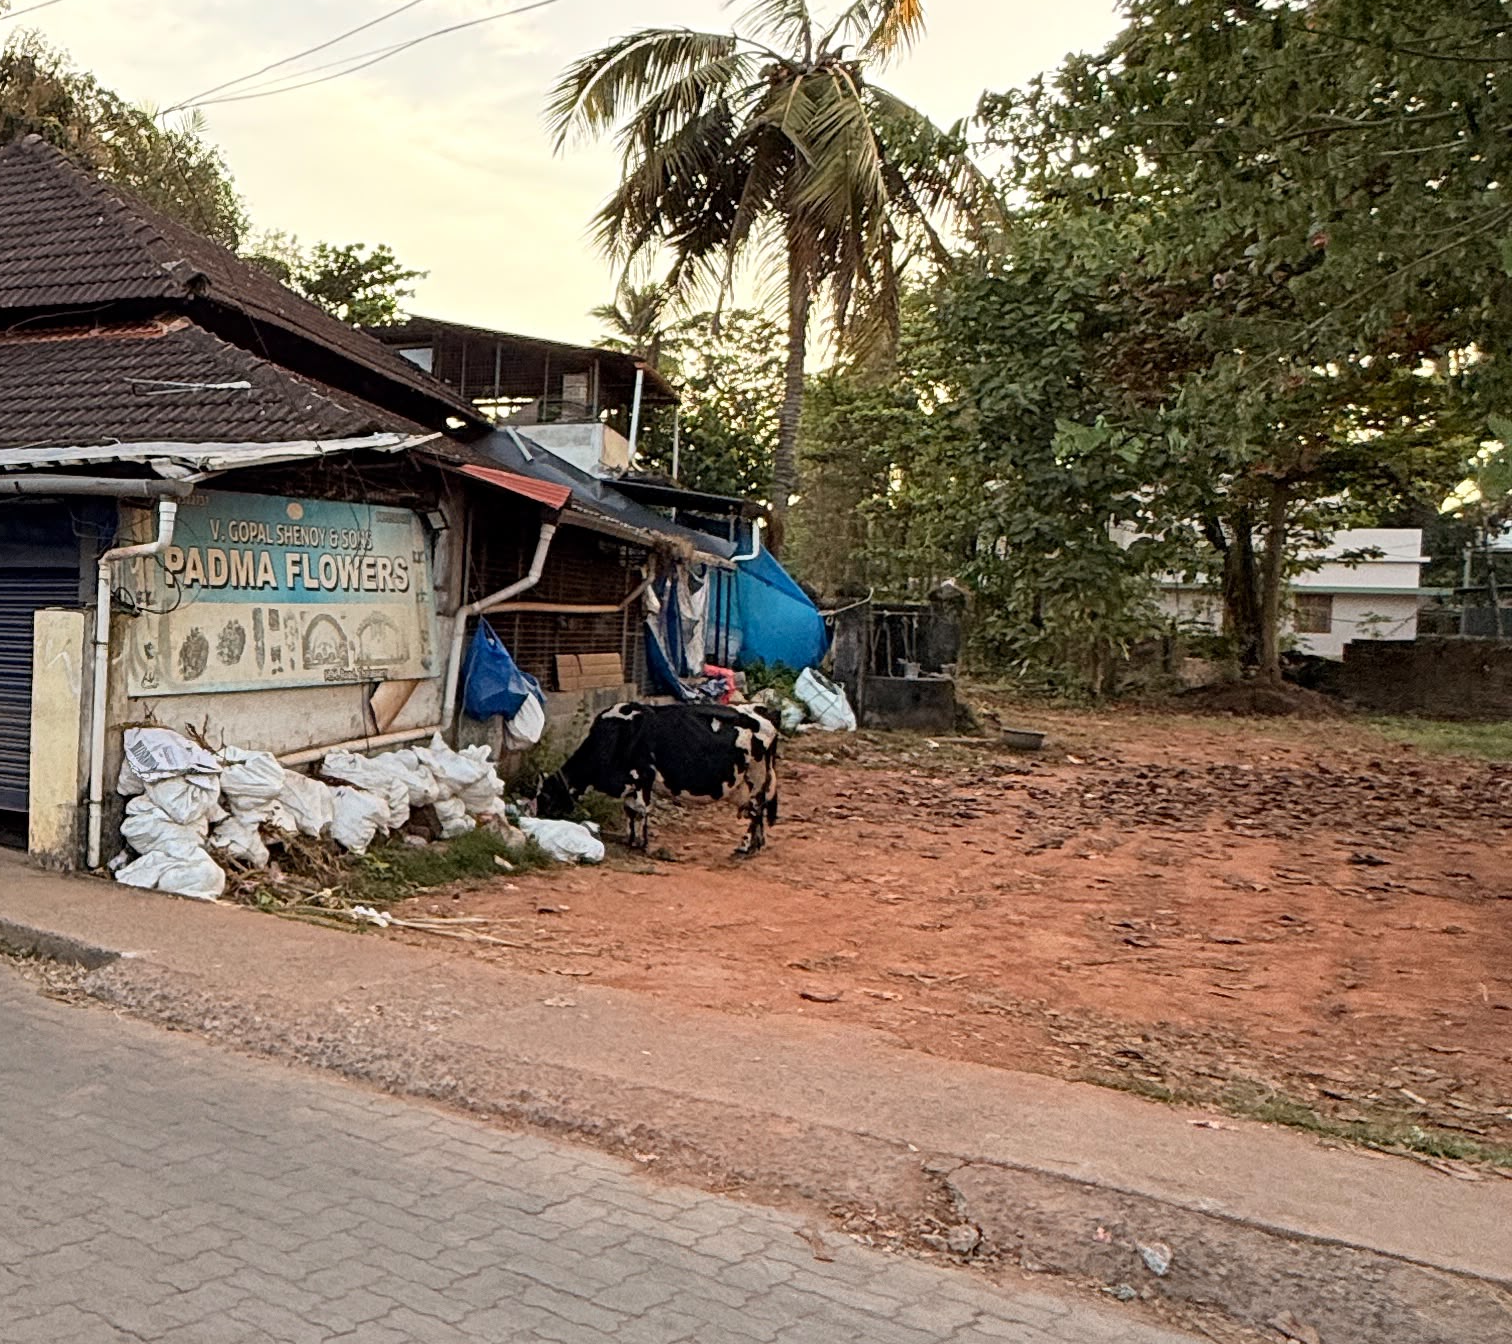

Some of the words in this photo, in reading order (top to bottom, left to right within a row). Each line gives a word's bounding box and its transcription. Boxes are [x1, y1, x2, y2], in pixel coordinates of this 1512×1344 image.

[210, 519, 226, 541] V.
[228, 520, 274, 544] GOPAL
[276, 524, 327, 548] SHENOY
[329, 528, 339, 548] &
[341, 528, 374, 550] SONS
[164, 546, 278, 589] PADMA
[285, 552, 410, 594] FLOWERS
